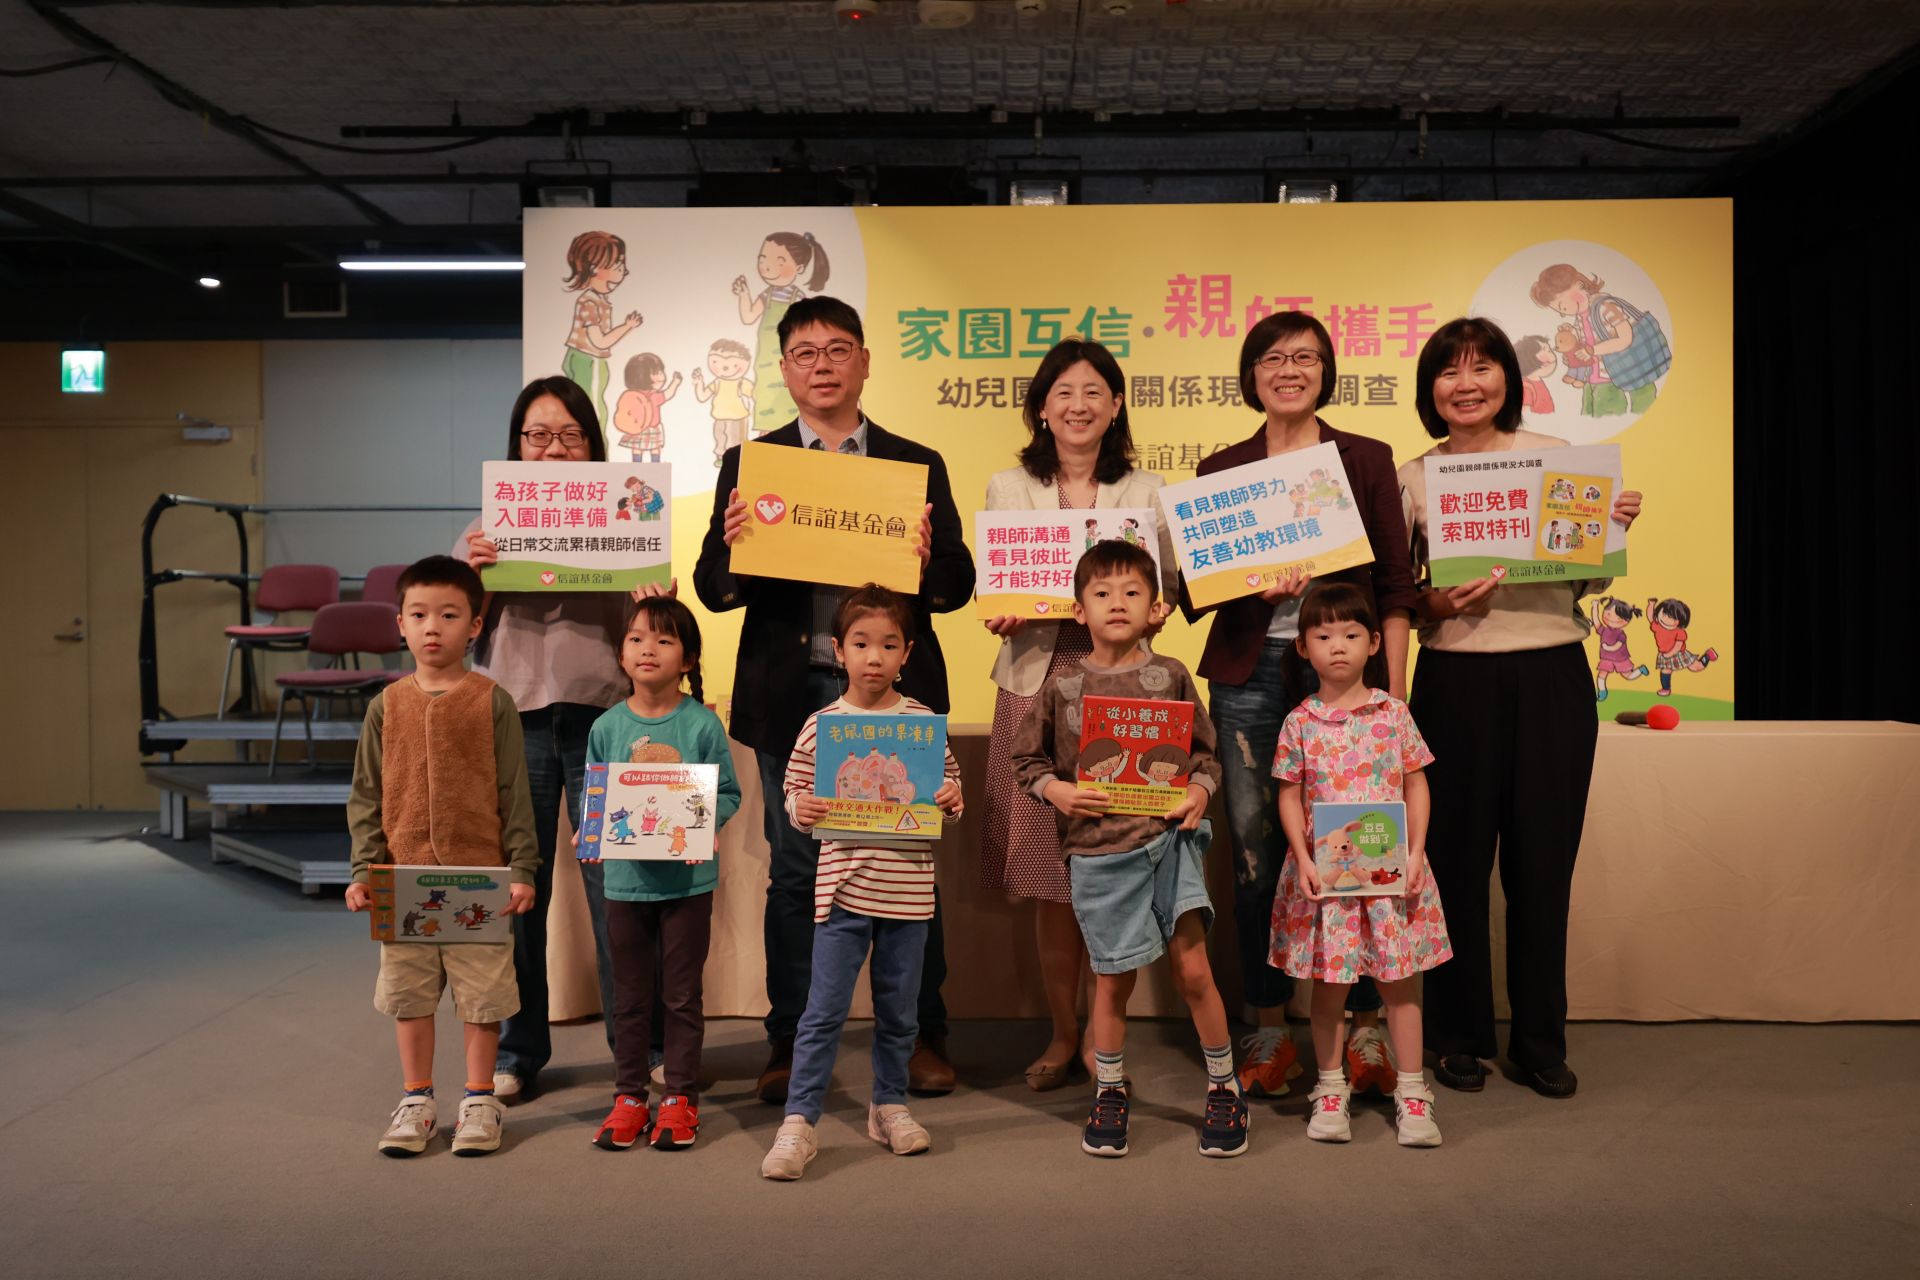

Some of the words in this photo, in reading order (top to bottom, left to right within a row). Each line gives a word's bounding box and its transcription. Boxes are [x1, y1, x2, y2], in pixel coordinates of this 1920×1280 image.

[494, 481, 608, 502] 為孩子做好
[1174, 477, 1287, 521] 看見親師努力
[1440, 489, 1529, 515] 歡迎免費
[494, 507, 608, 528] 入園前準備
[791, 504, 906, 538] 信誼基金會
[1181, 509, 1259, 544] 共同塑造
[987, 525, 1071, 545] 親師溝通
[1441, 517, 1531, 543] 索取特刊
[494, 536, 662, 553] 從日常交流累積親師信任
[1188, 517, 1322, 571] 友善幼教環境
[987, 547, 1073, 567] 看見彼此
[557, 572, 613, 584] 信誼基金會
[988, 569, 1073, 589] 才能好好
[1508, 564, 1566, 577] 信誼基金會
[1106, 706, 1169, 723] 從小養成
[1112, 723, 1160, 740] 好習慣
